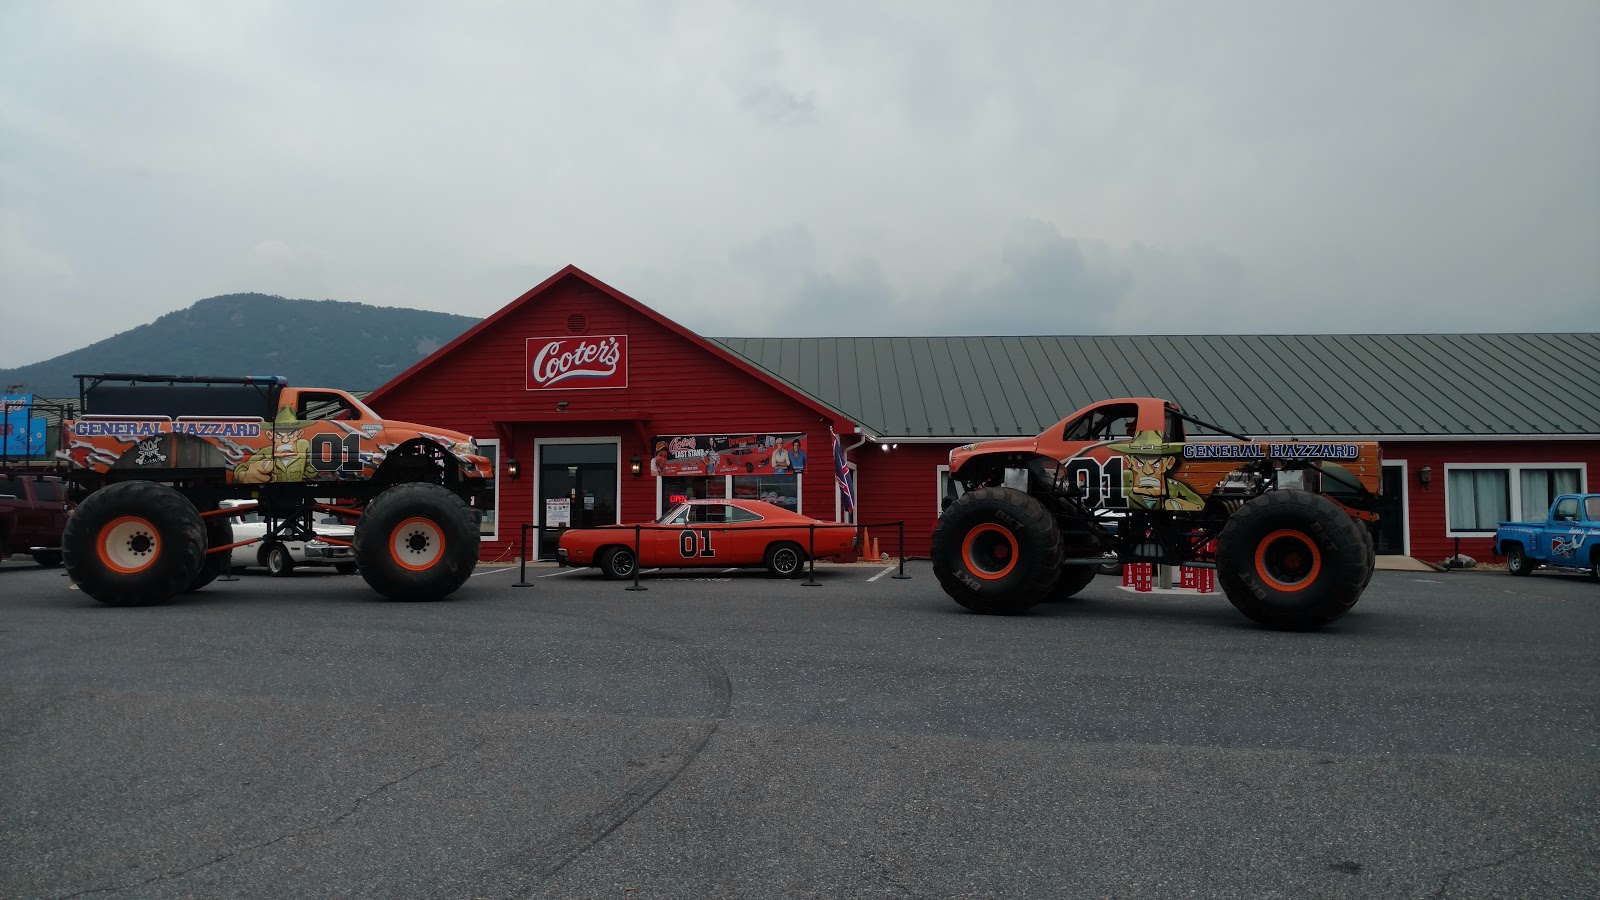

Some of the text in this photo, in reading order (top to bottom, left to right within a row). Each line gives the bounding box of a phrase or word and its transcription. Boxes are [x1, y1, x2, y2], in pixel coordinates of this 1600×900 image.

[532, 337, 620, 386] Cooter's
[75, 422, 261, 437] GENERAL HAZZARD
[310, 432, 364, 471] 01
[1183, 444, 1359, 458] GENERAL HAZZARD
[1065, 456, 1129, 509] 01
[669, 495, 687, 503] OPEN
[994, 509, 1025, 530] BKT
[679, 529, 716, 558] 01
[951, 570, 982, 592] BKT
